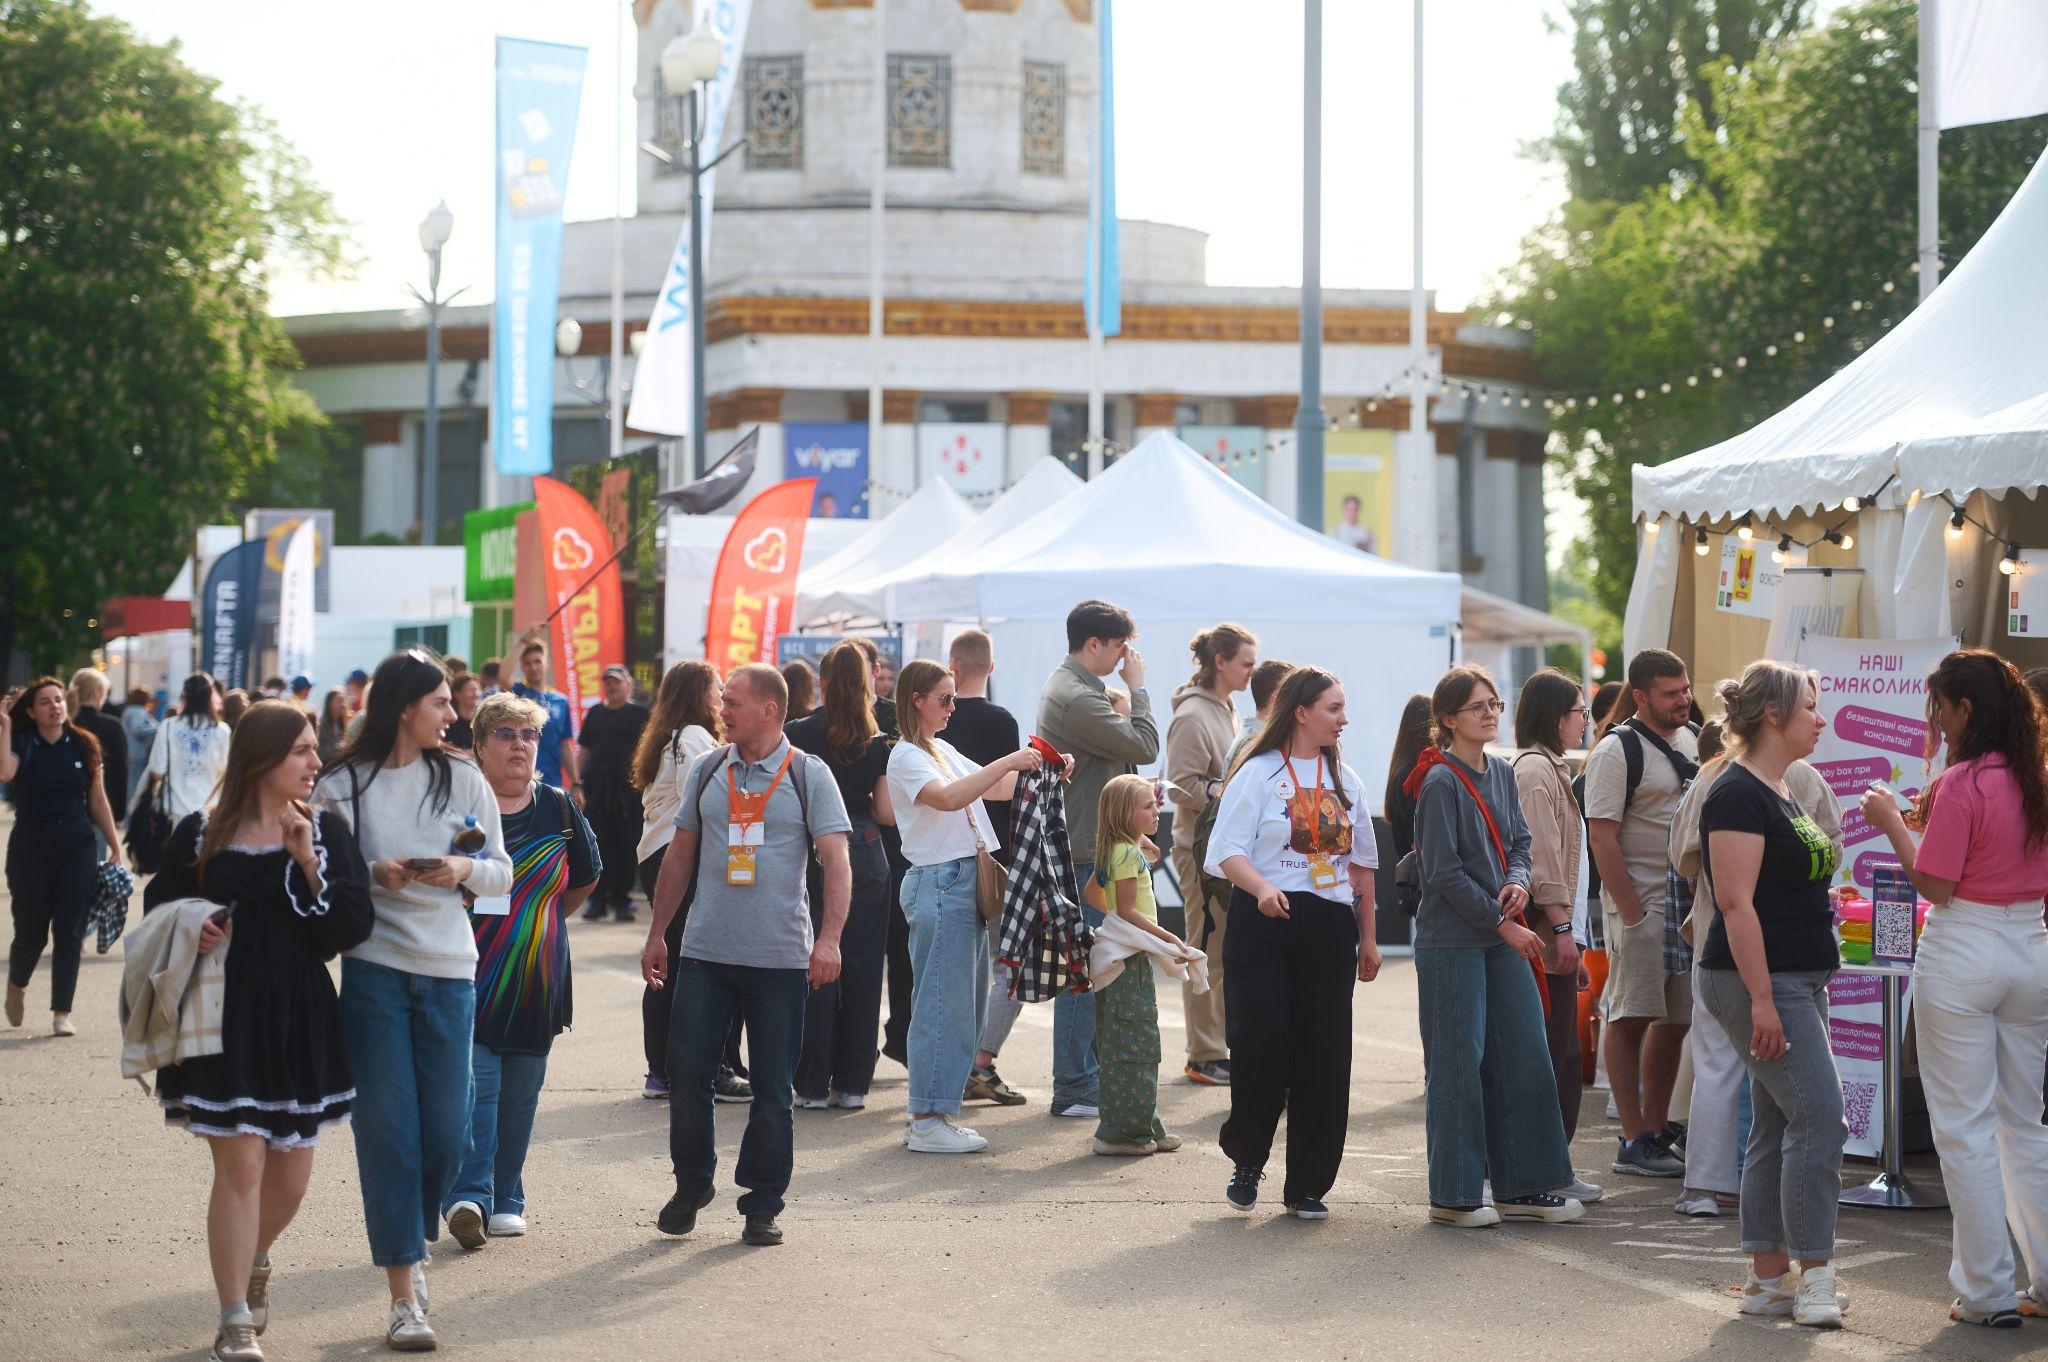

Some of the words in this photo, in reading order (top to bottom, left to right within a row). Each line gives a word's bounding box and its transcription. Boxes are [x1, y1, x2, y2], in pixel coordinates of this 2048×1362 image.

[727, 587, 762, 670] АРТ
[1860, 655, 1903, 671] НАШІ
[1846, 711, 1897, 729] безкоштовні
[1864, 729, 1912, 747] консультації
[1837, 766, 1852, 776] box
[1854, 765, 1871, 775] при
[1280, 860, 1309, 869] TRUS
[1829, 975, 1860, 985] манітні
[1831, 986, 1875, 998] лояльності
[1830, 1026, 1882, 1041] сихологічних
[1830, 1038, 1880, 1054] півробітників
